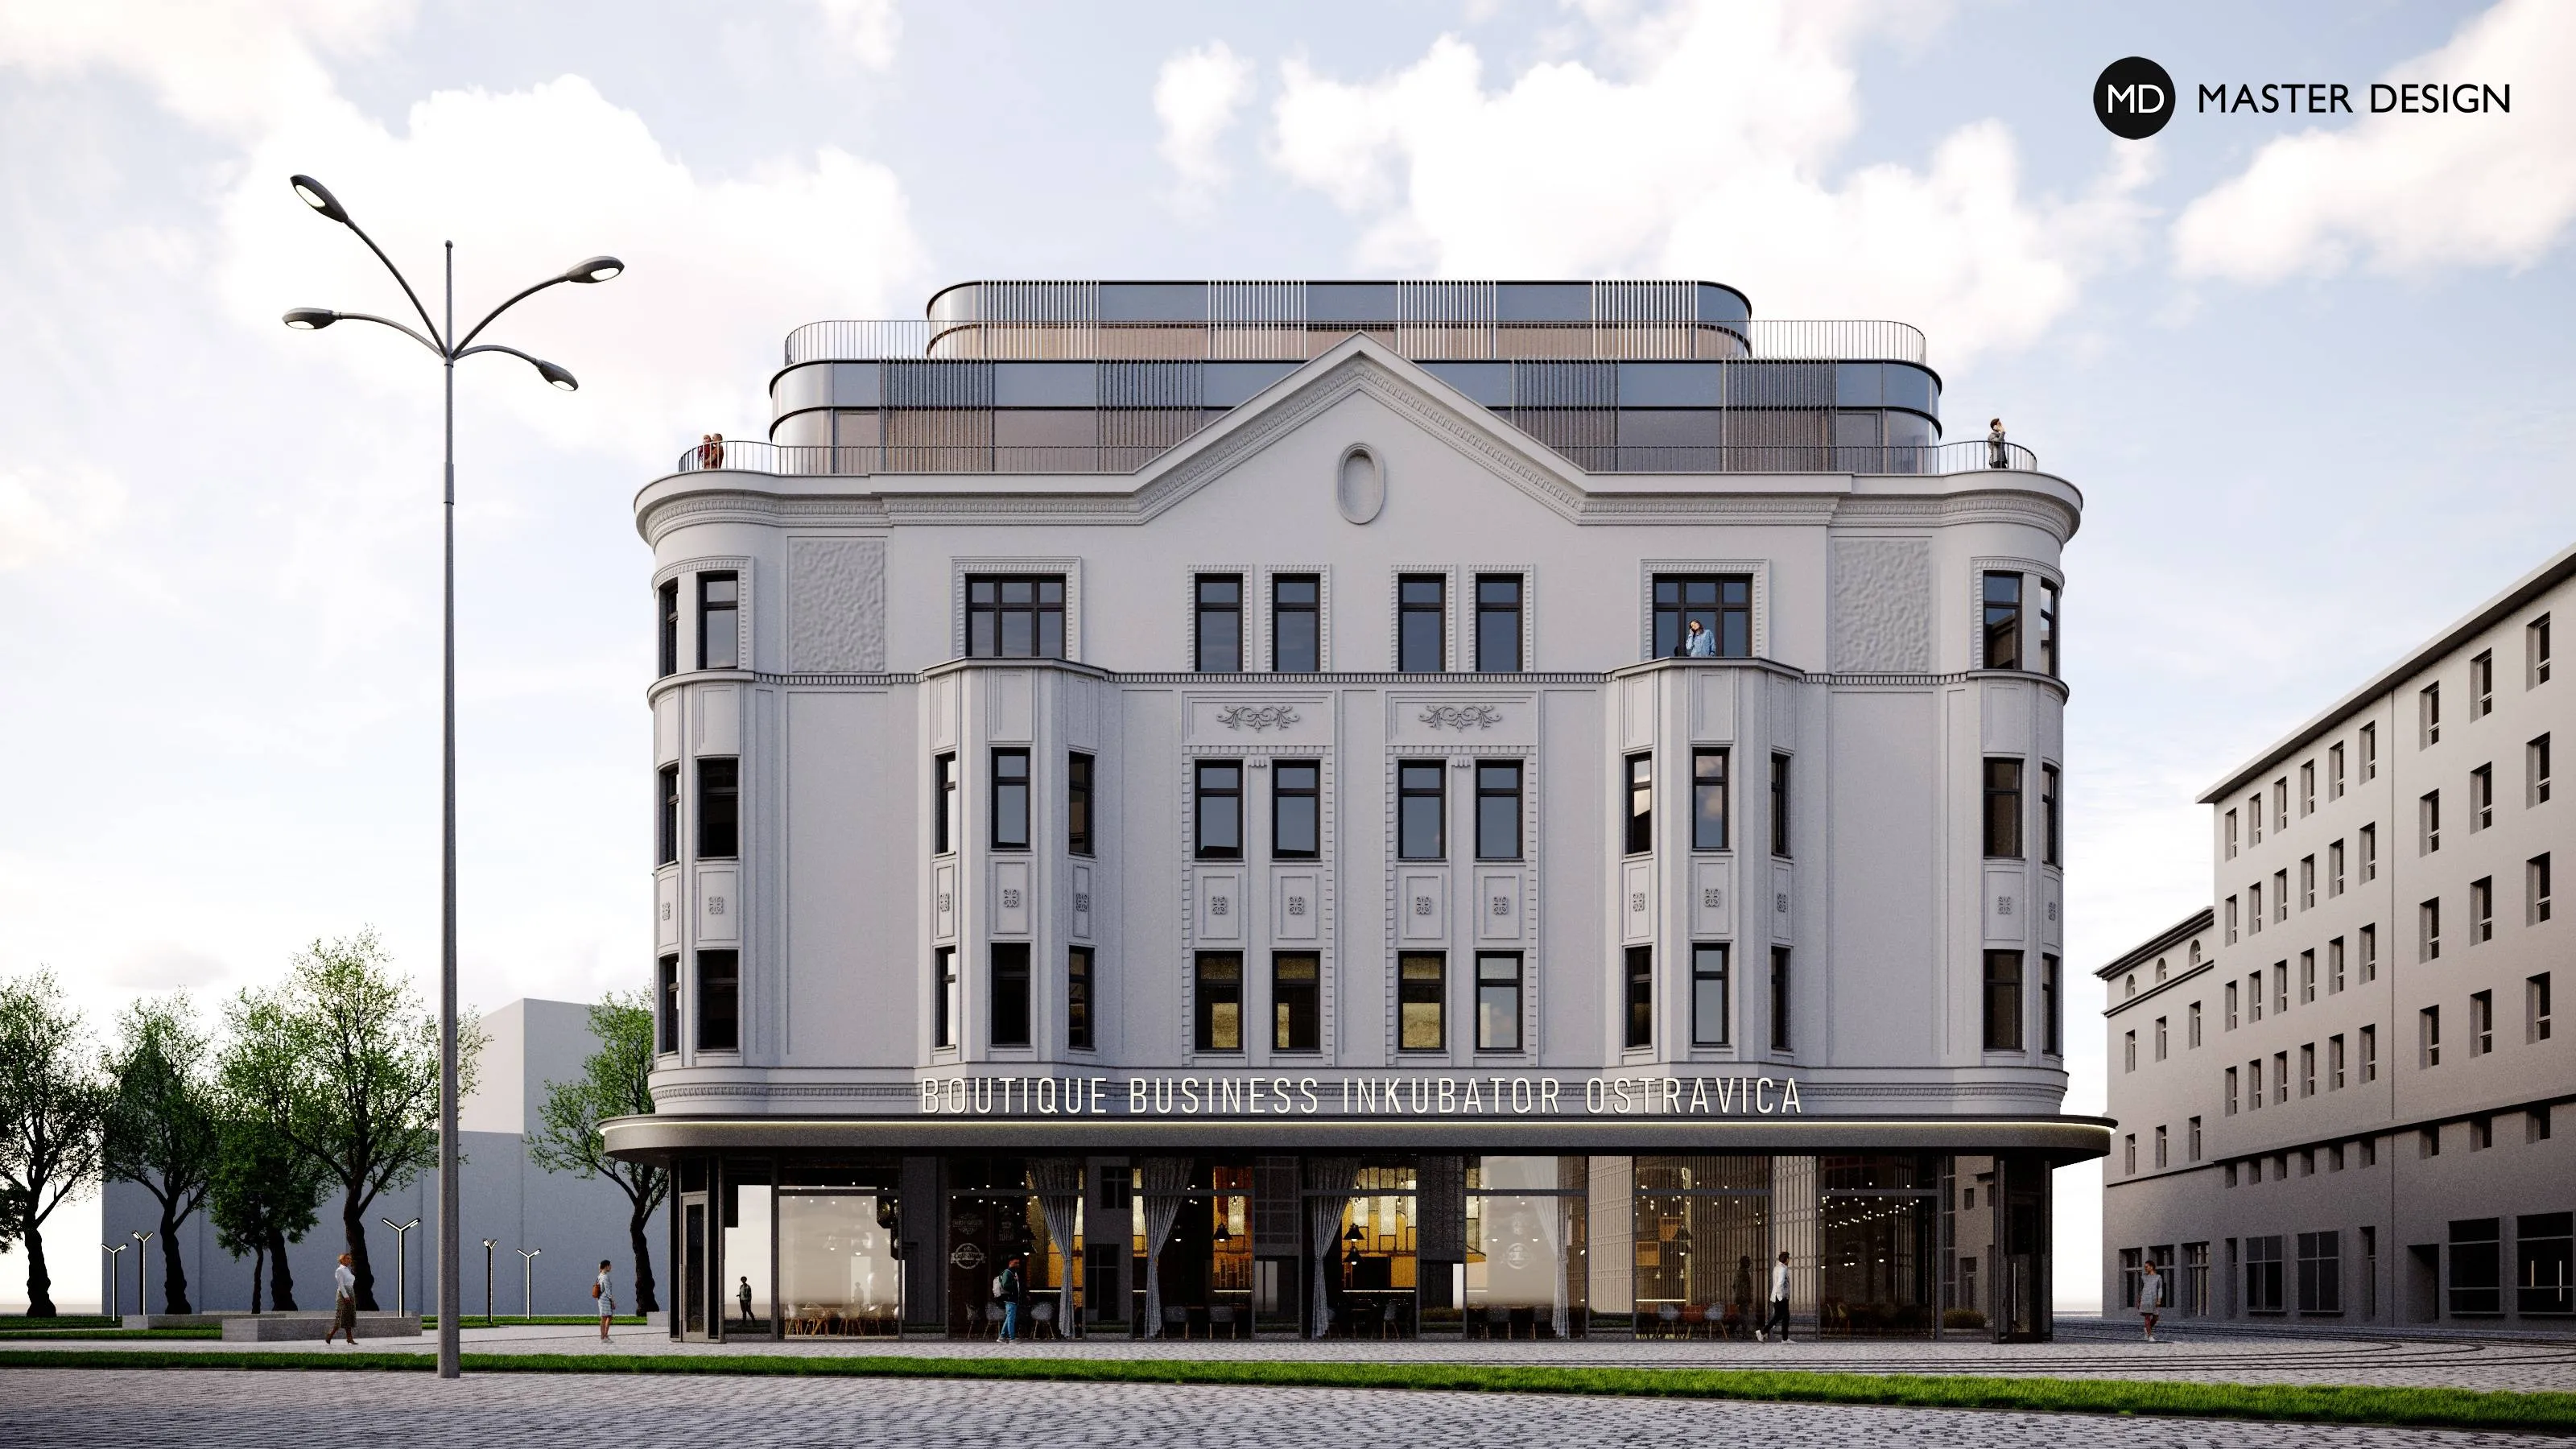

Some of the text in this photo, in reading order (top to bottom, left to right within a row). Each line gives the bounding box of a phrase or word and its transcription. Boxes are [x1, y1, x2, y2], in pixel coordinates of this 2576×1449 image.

[921, 1077, 1802, 1114] BOUTIQUE BUSINESS INKUBATOR OSTRAVICA
